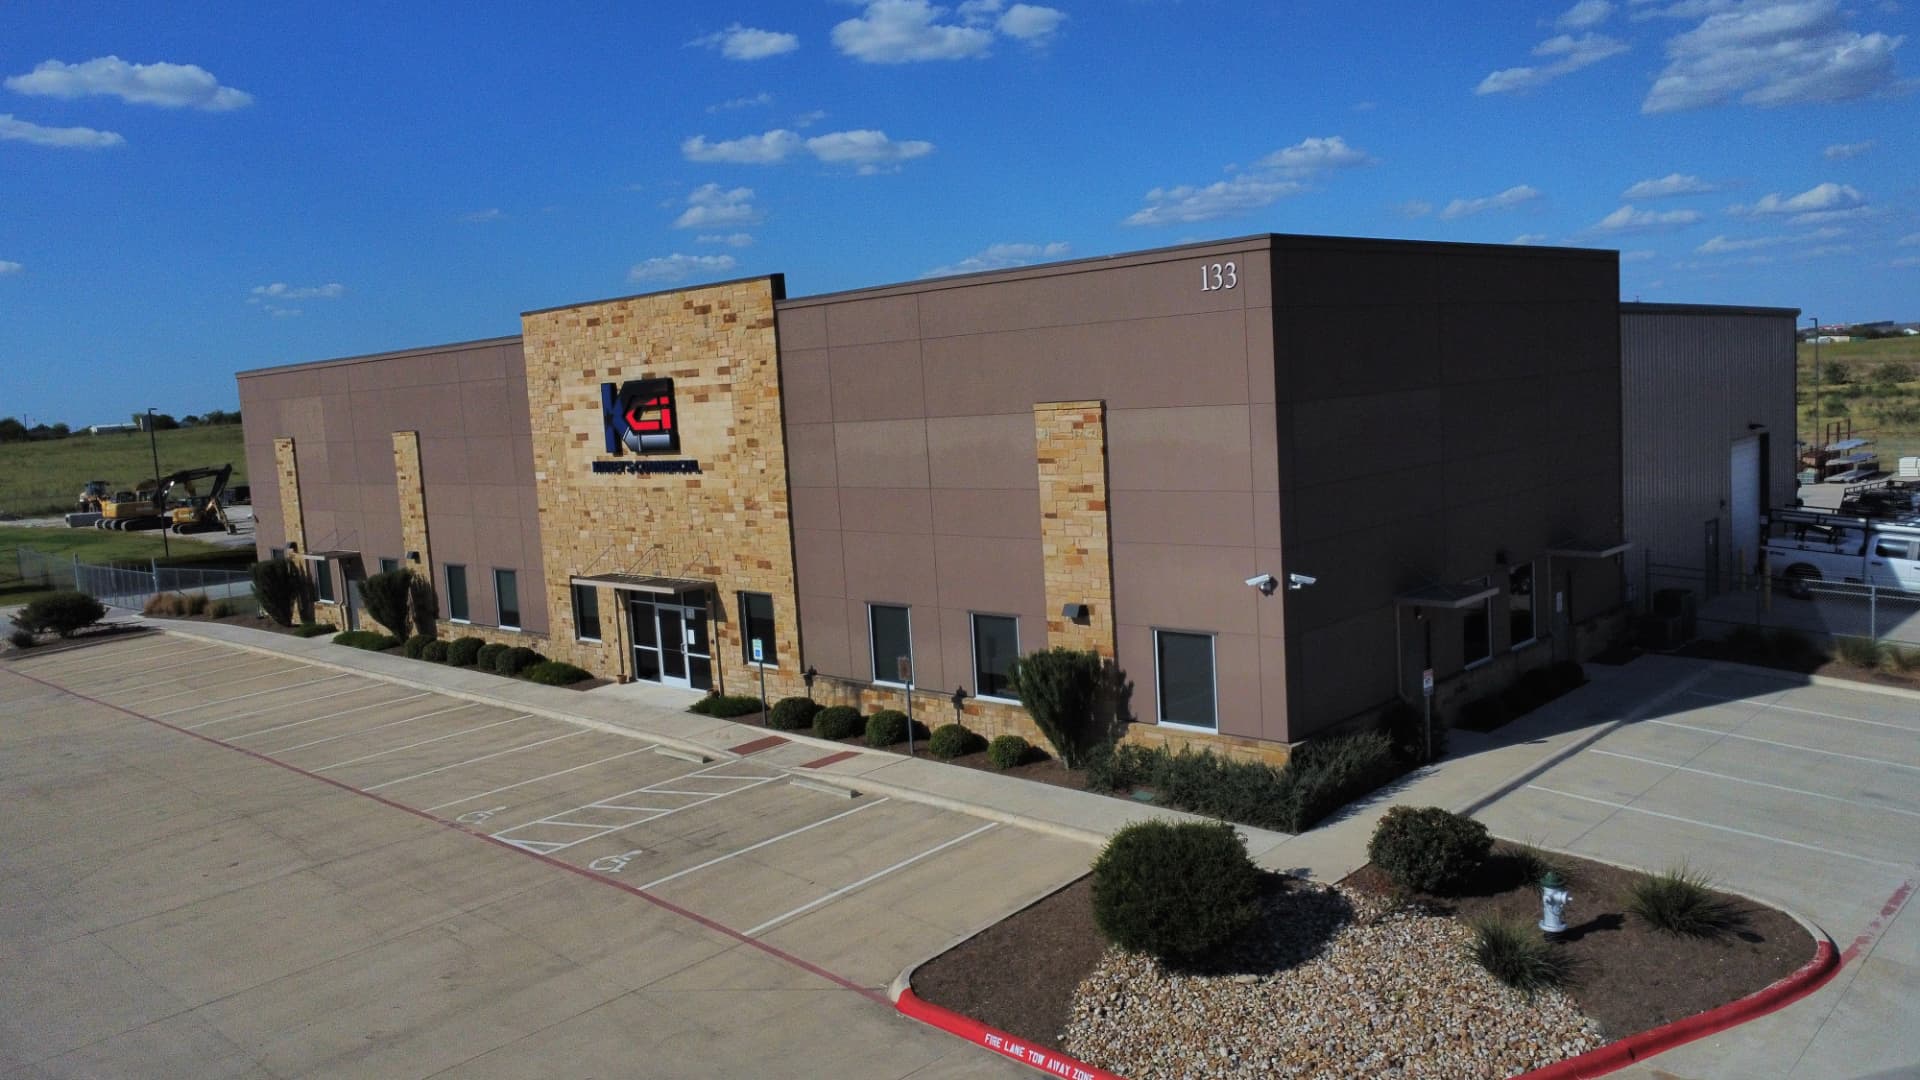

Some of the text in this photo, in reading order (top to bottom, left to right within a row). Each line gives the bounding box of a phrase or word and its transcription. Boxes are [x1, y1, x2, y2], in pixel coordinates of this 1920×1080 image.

[1201, 262, 1237, 291] 133
[985, 1033, 1003, 1048] FIRE
[1004, 1041, 1025, 1058] LANE
[1028, 1050, 1045, 1065] TOW
[1047, 1059, 1071, 1076] AWAY
